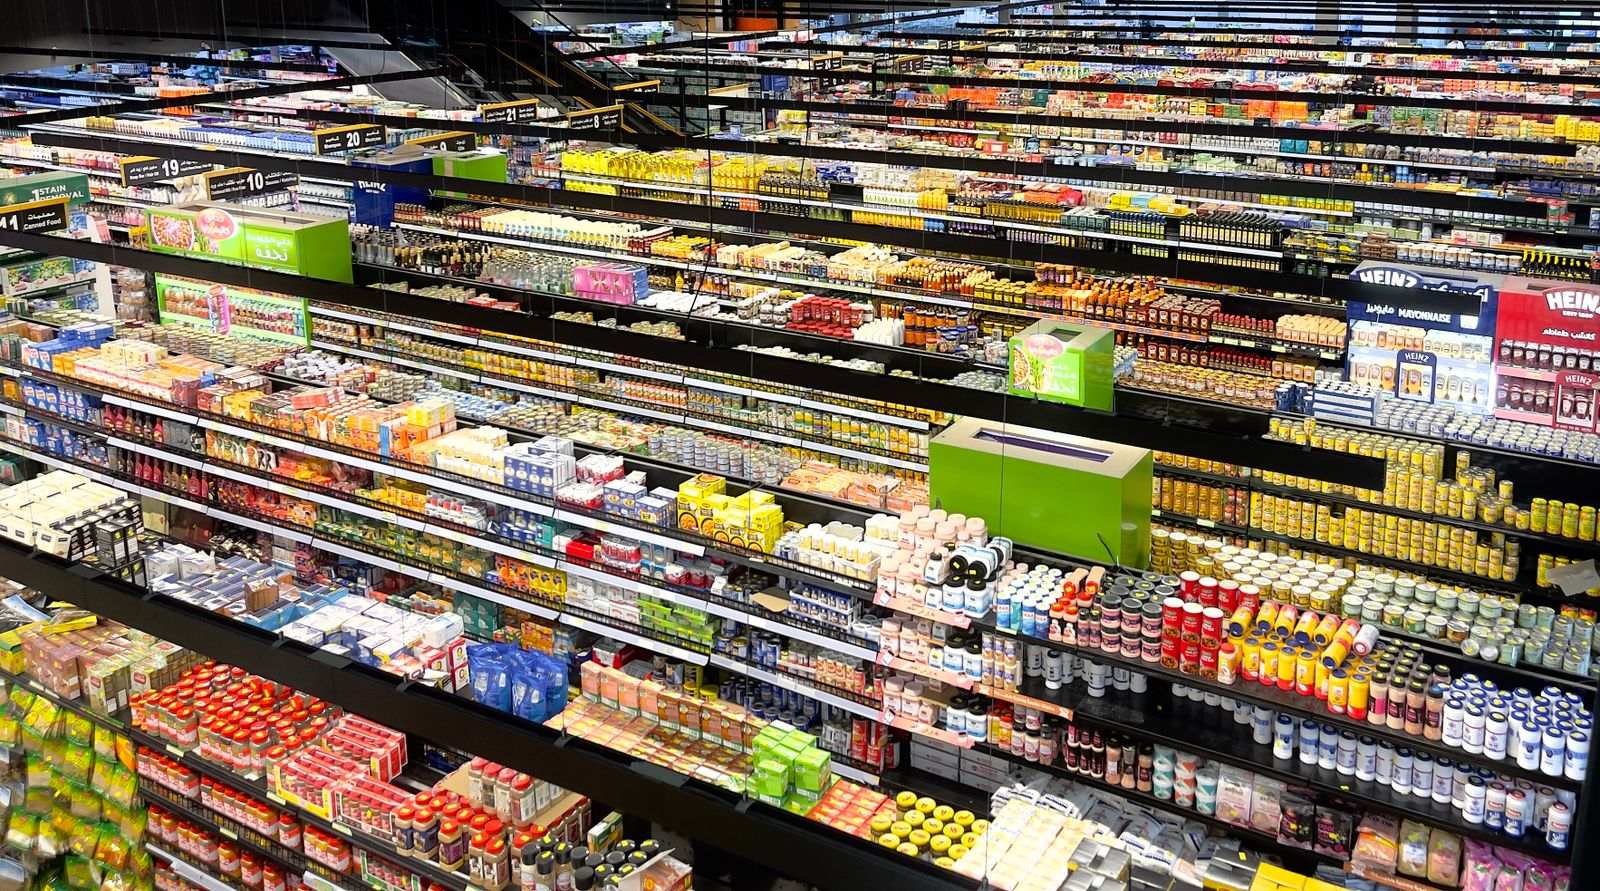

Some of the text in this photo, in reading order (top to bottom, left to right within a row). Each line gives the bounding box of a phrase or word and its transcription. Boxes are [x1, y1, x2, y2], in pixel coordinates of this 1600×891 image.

[506, 107, 517, 121] 21
[593, 114, 600, 129] 8
[346, 131, 360, 148] 20
[439, 141, 447, 151] 9
[161, 159, 179, 177] 19
[246, 172, 264, 191] 10
[40, 184, 67, 196] STAIN
[23, 218, 62, 231] Canned Food
[1398, 308, 1452, 323] MAYONNAISE
[1404, 352, 1430, 362] HEINZ
[1564, 374, 1593, 386] HEINZ
